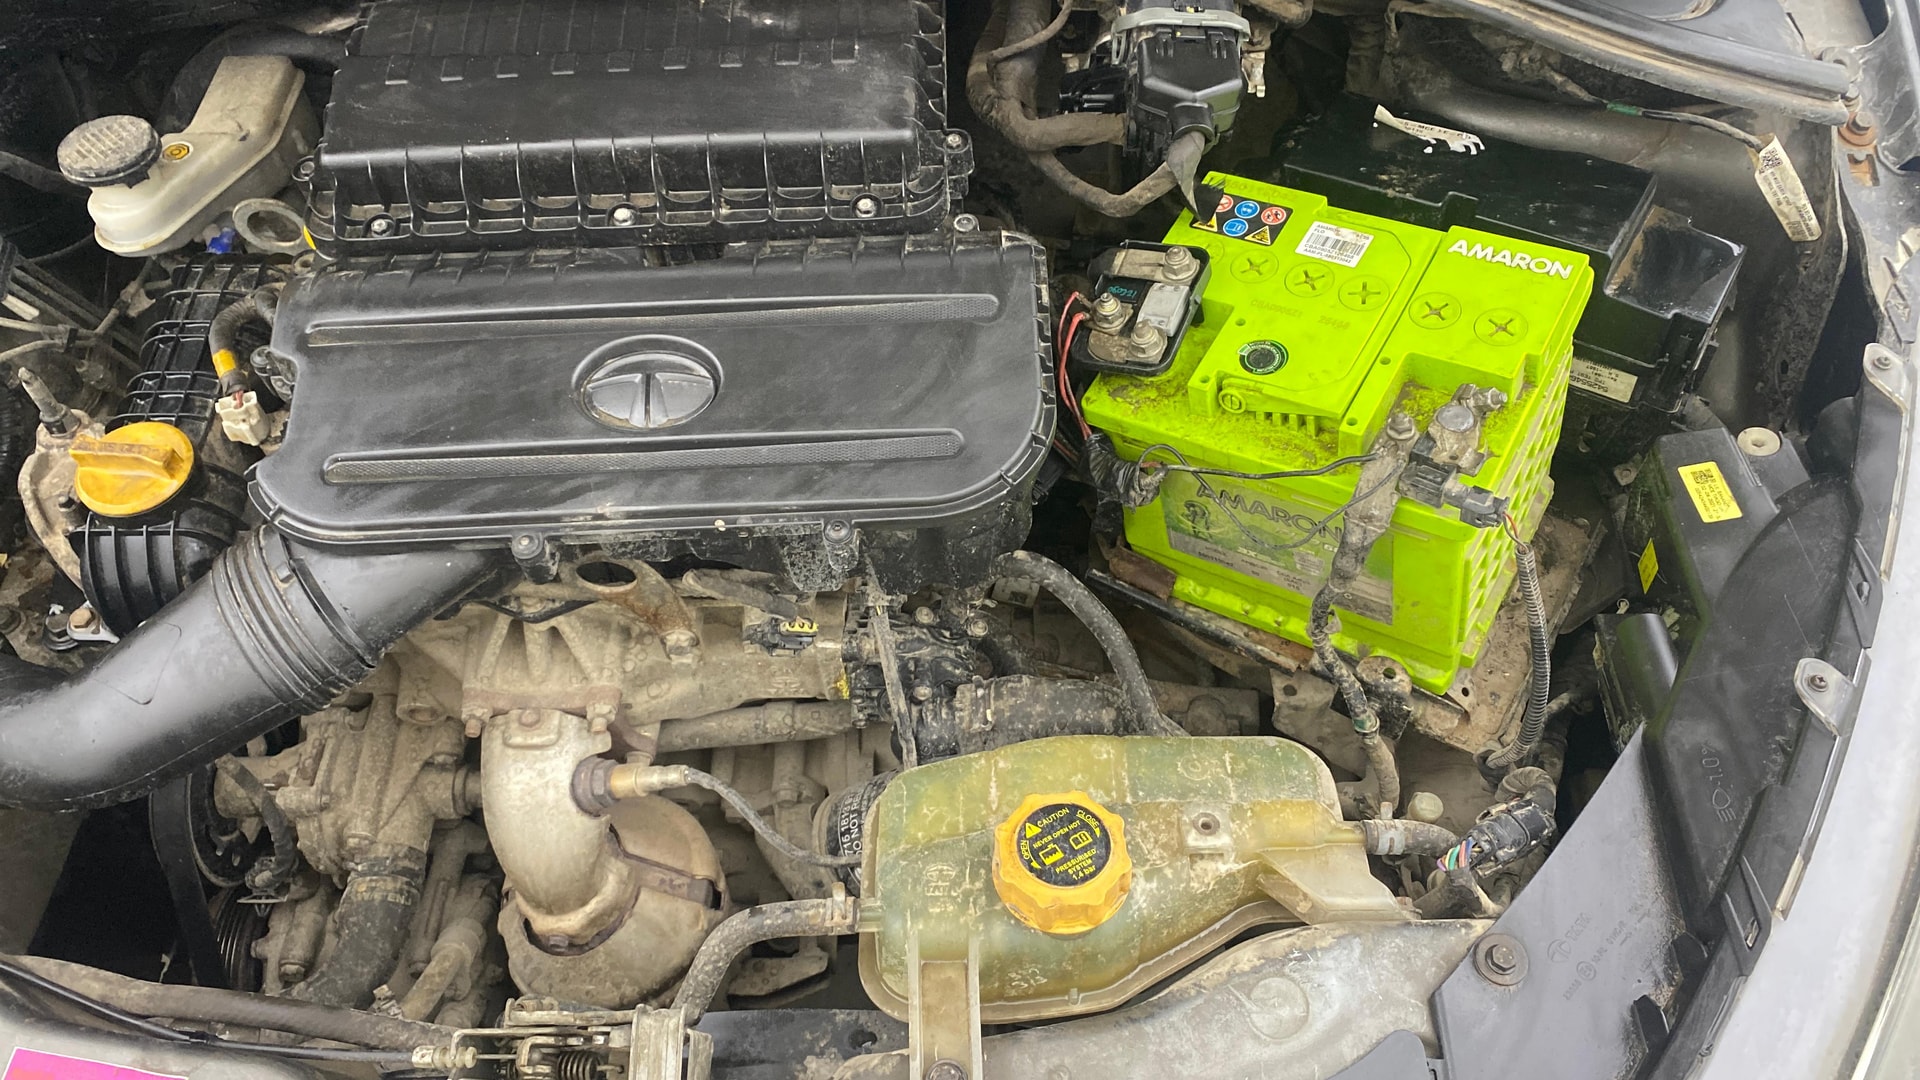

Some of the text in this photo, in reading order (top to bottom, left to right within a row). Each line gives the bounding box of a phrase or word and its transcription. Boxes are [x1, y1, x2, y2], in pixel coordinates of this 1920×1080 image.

[1447, 239, 1574, 280] AMARON
[1196, 483, 1343, 545] AMARON
[849, 812, 860, 839] NOT
[1037, 807, 1100, 828] CAUTION CLOSE
[1033, 819, 1081, 849] NEVER OPEN HOT
[1020, 839, 1031, 860] OPEN
[1056, 848, 1097, 874] PRESSURISED
[1067, 858, 1093, 875] SYSTEM
[1083, 864, 1097, 875] bar
